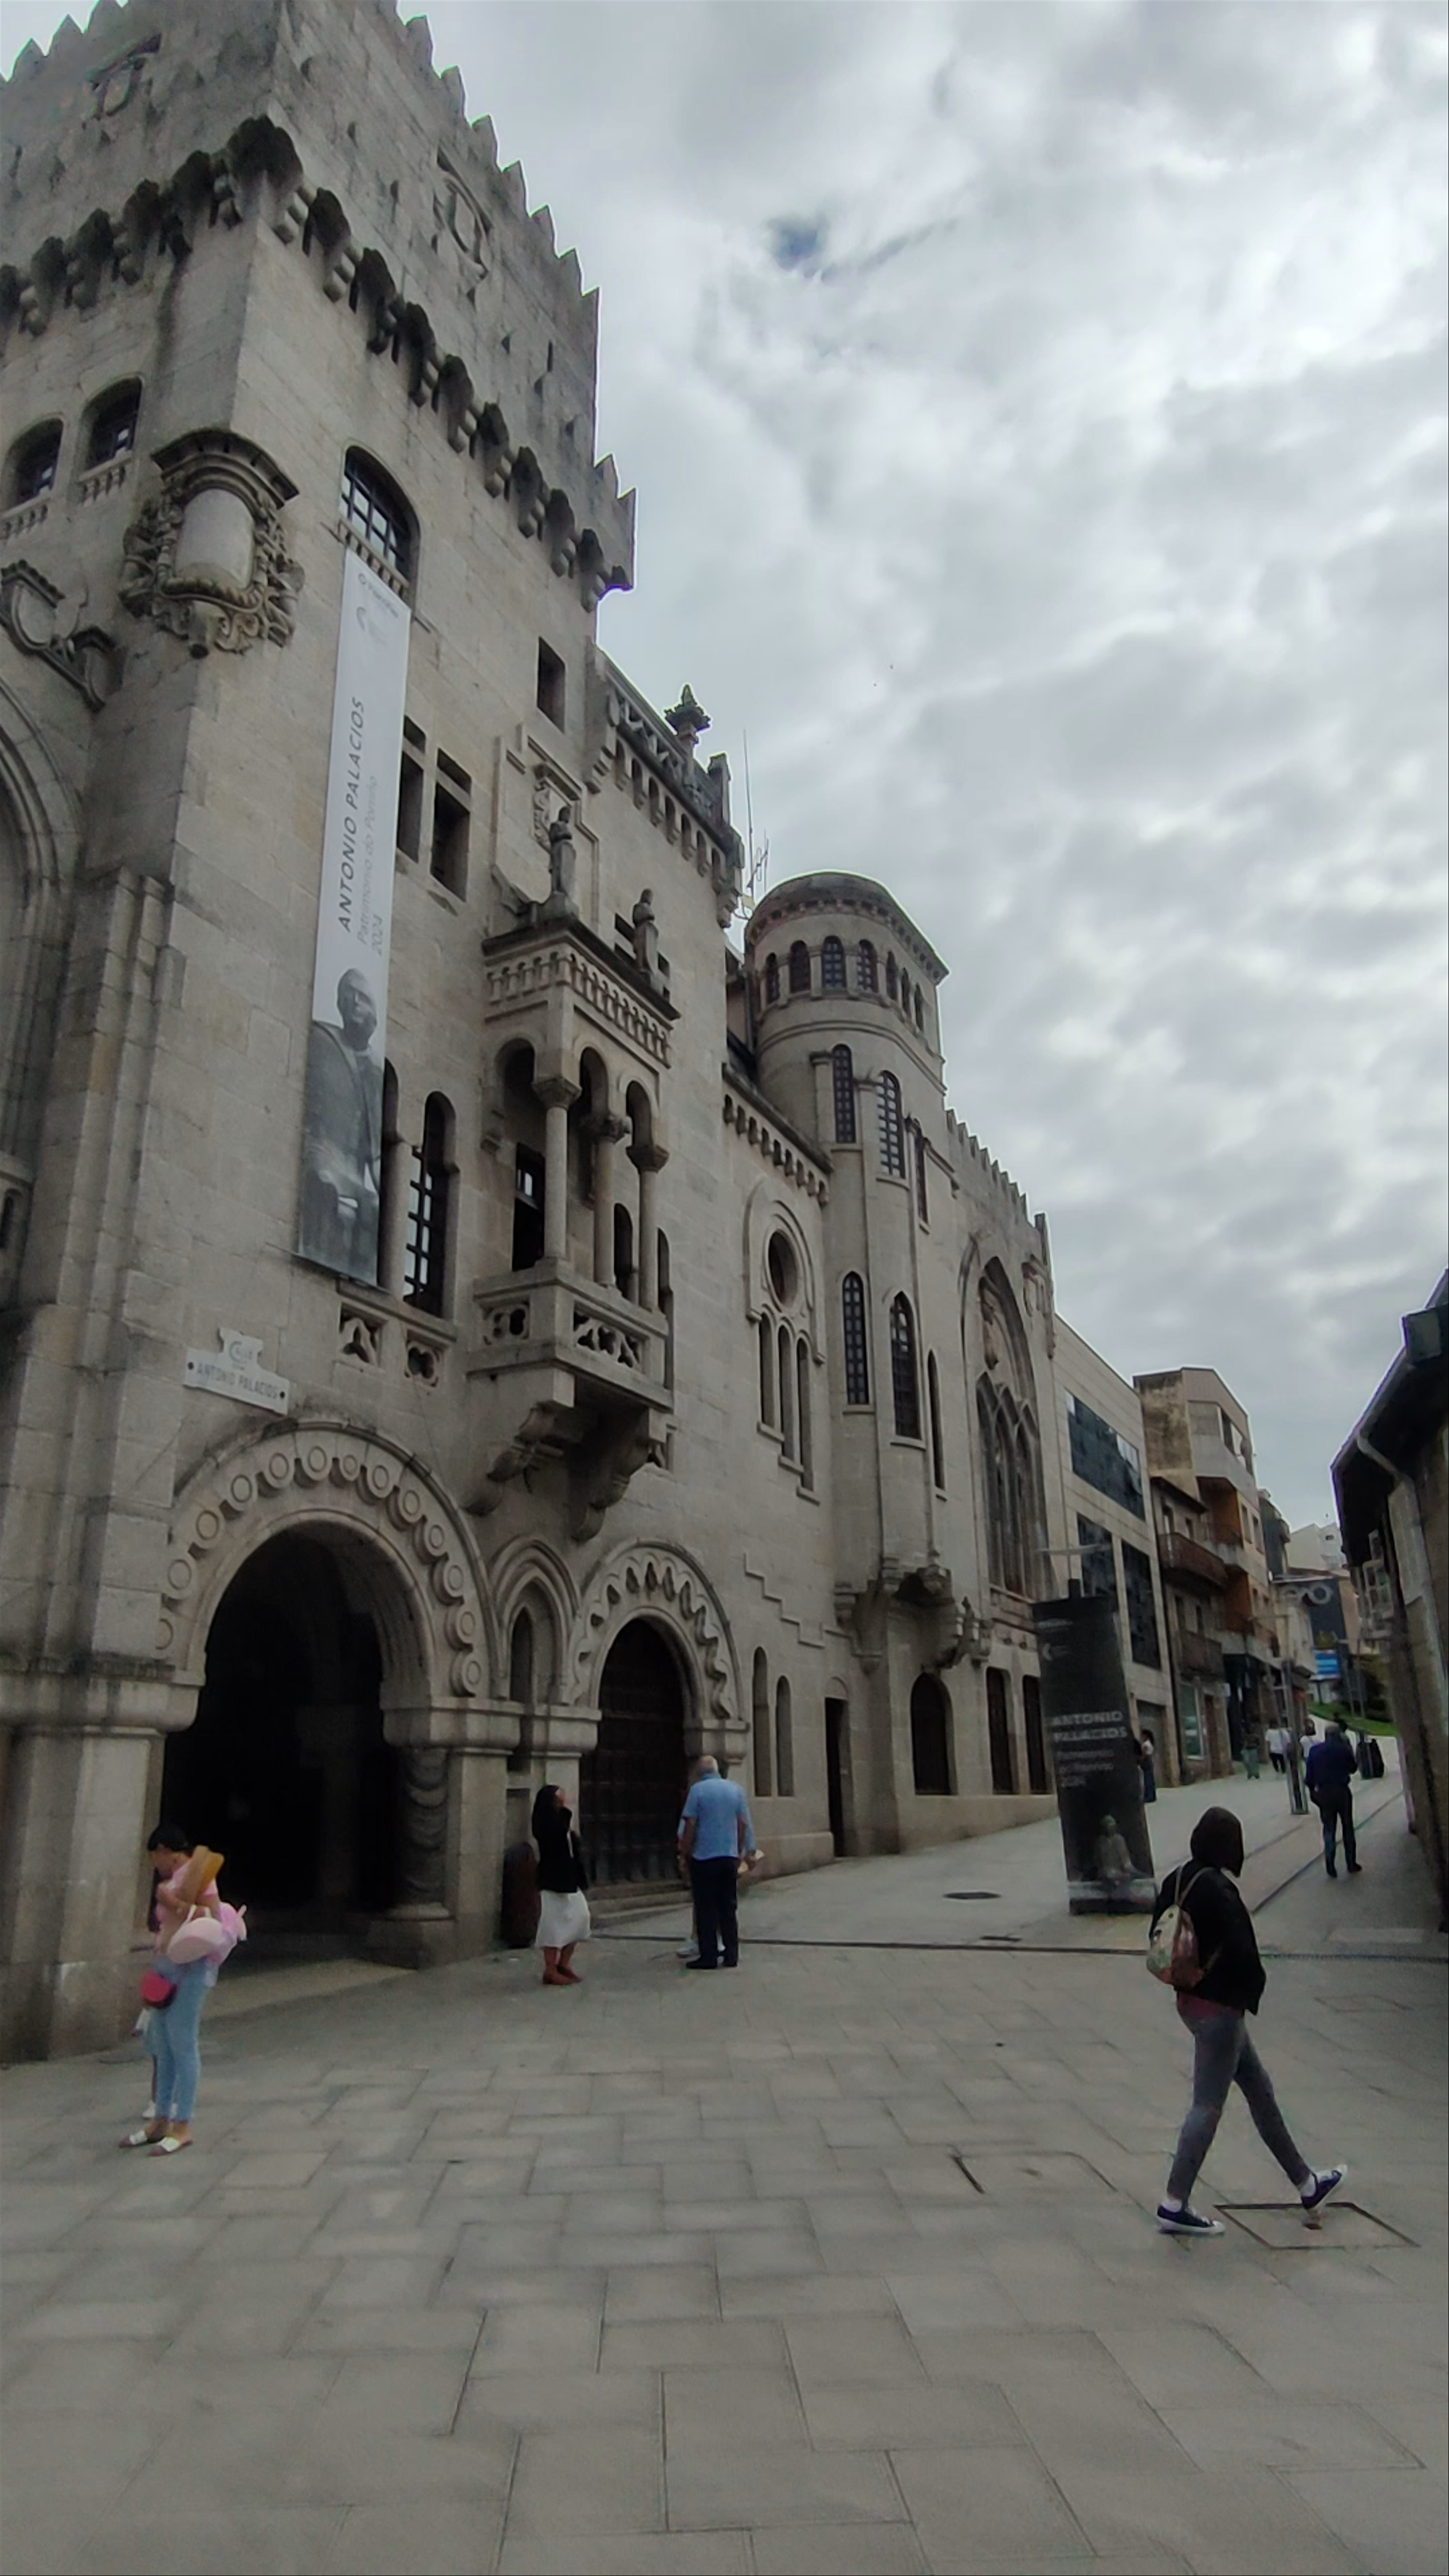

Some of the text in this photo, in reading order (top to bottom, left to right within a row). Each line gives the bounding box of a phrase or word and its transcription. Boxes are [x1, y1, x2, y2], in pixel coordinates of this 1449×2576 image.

[338, 697, 364, 933] ANTONIO PALACIOS
[1051, 1711, 1123, 1726] ANTONIO
